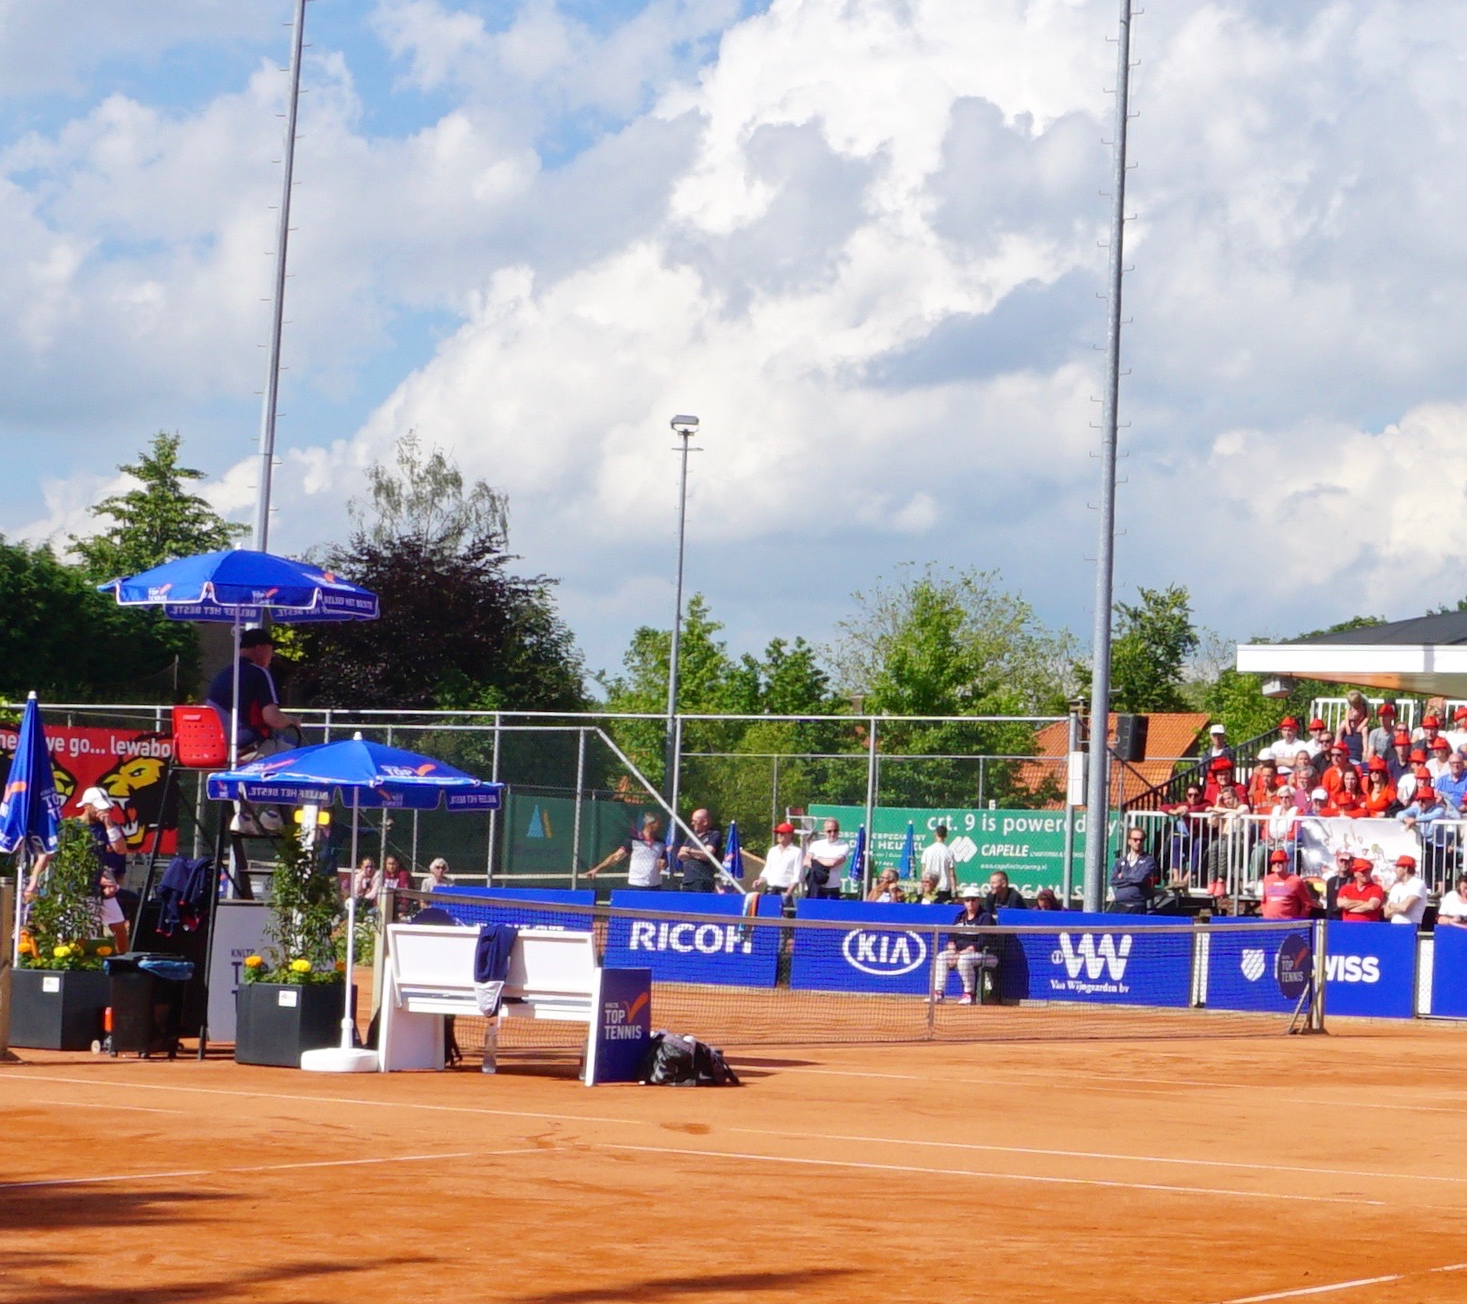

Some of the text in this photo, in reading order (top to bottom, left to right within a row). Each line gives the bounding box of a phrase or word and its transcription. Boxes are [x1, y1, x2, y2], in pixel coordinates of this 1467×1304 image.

[111, 735, 171, 758] lewabo
[965, 814, 975, 831] 9
[982, 814, 997, 832] is
[981, 844, 1029, 857] CAPELLE
[857, 934, 911, 964] KIA
[1282, 960, 1294, 971] TOP
[1281, 971, 1303, 983] TENNIS
[605, 1009, 625, 1024] TOP
[604, 1025, 642, 1040] TENNIS
